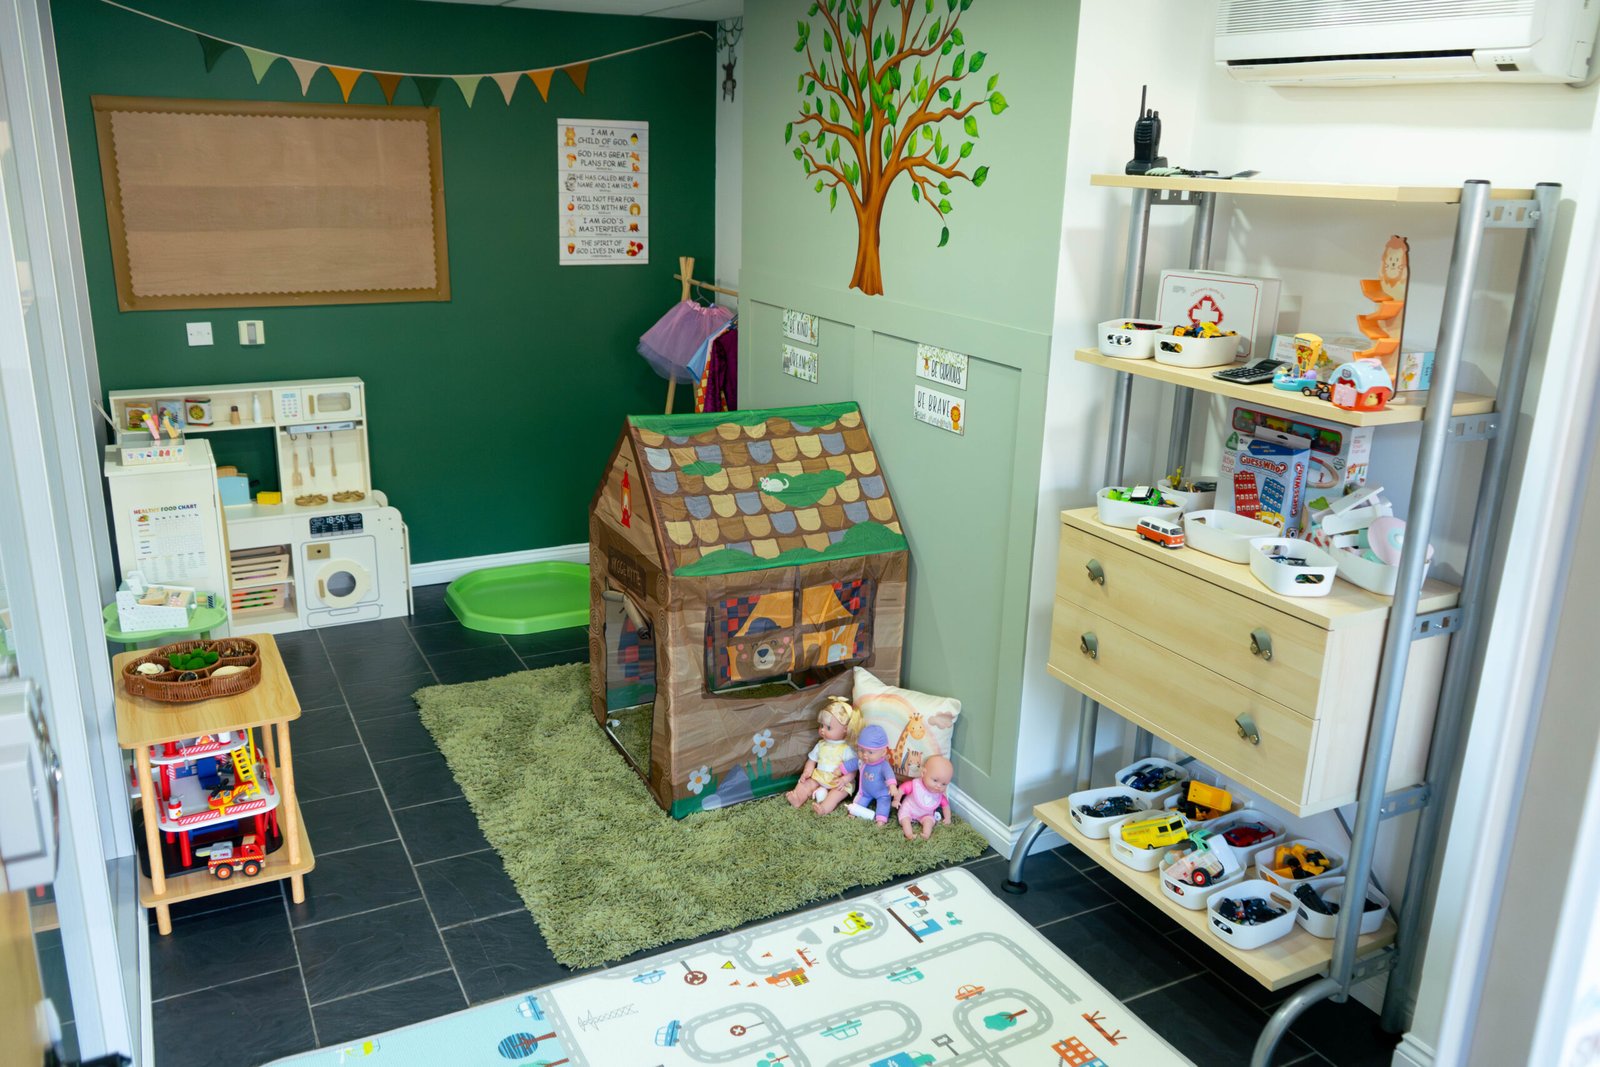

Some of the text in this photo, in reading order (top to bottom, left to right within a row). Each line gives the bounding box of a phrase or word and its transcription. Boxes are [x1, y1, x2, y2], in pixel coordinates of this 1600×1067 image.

[931, 360, 961, 384] BE CURIOUS
[918, 390, 950, 418] BE BRAVE
